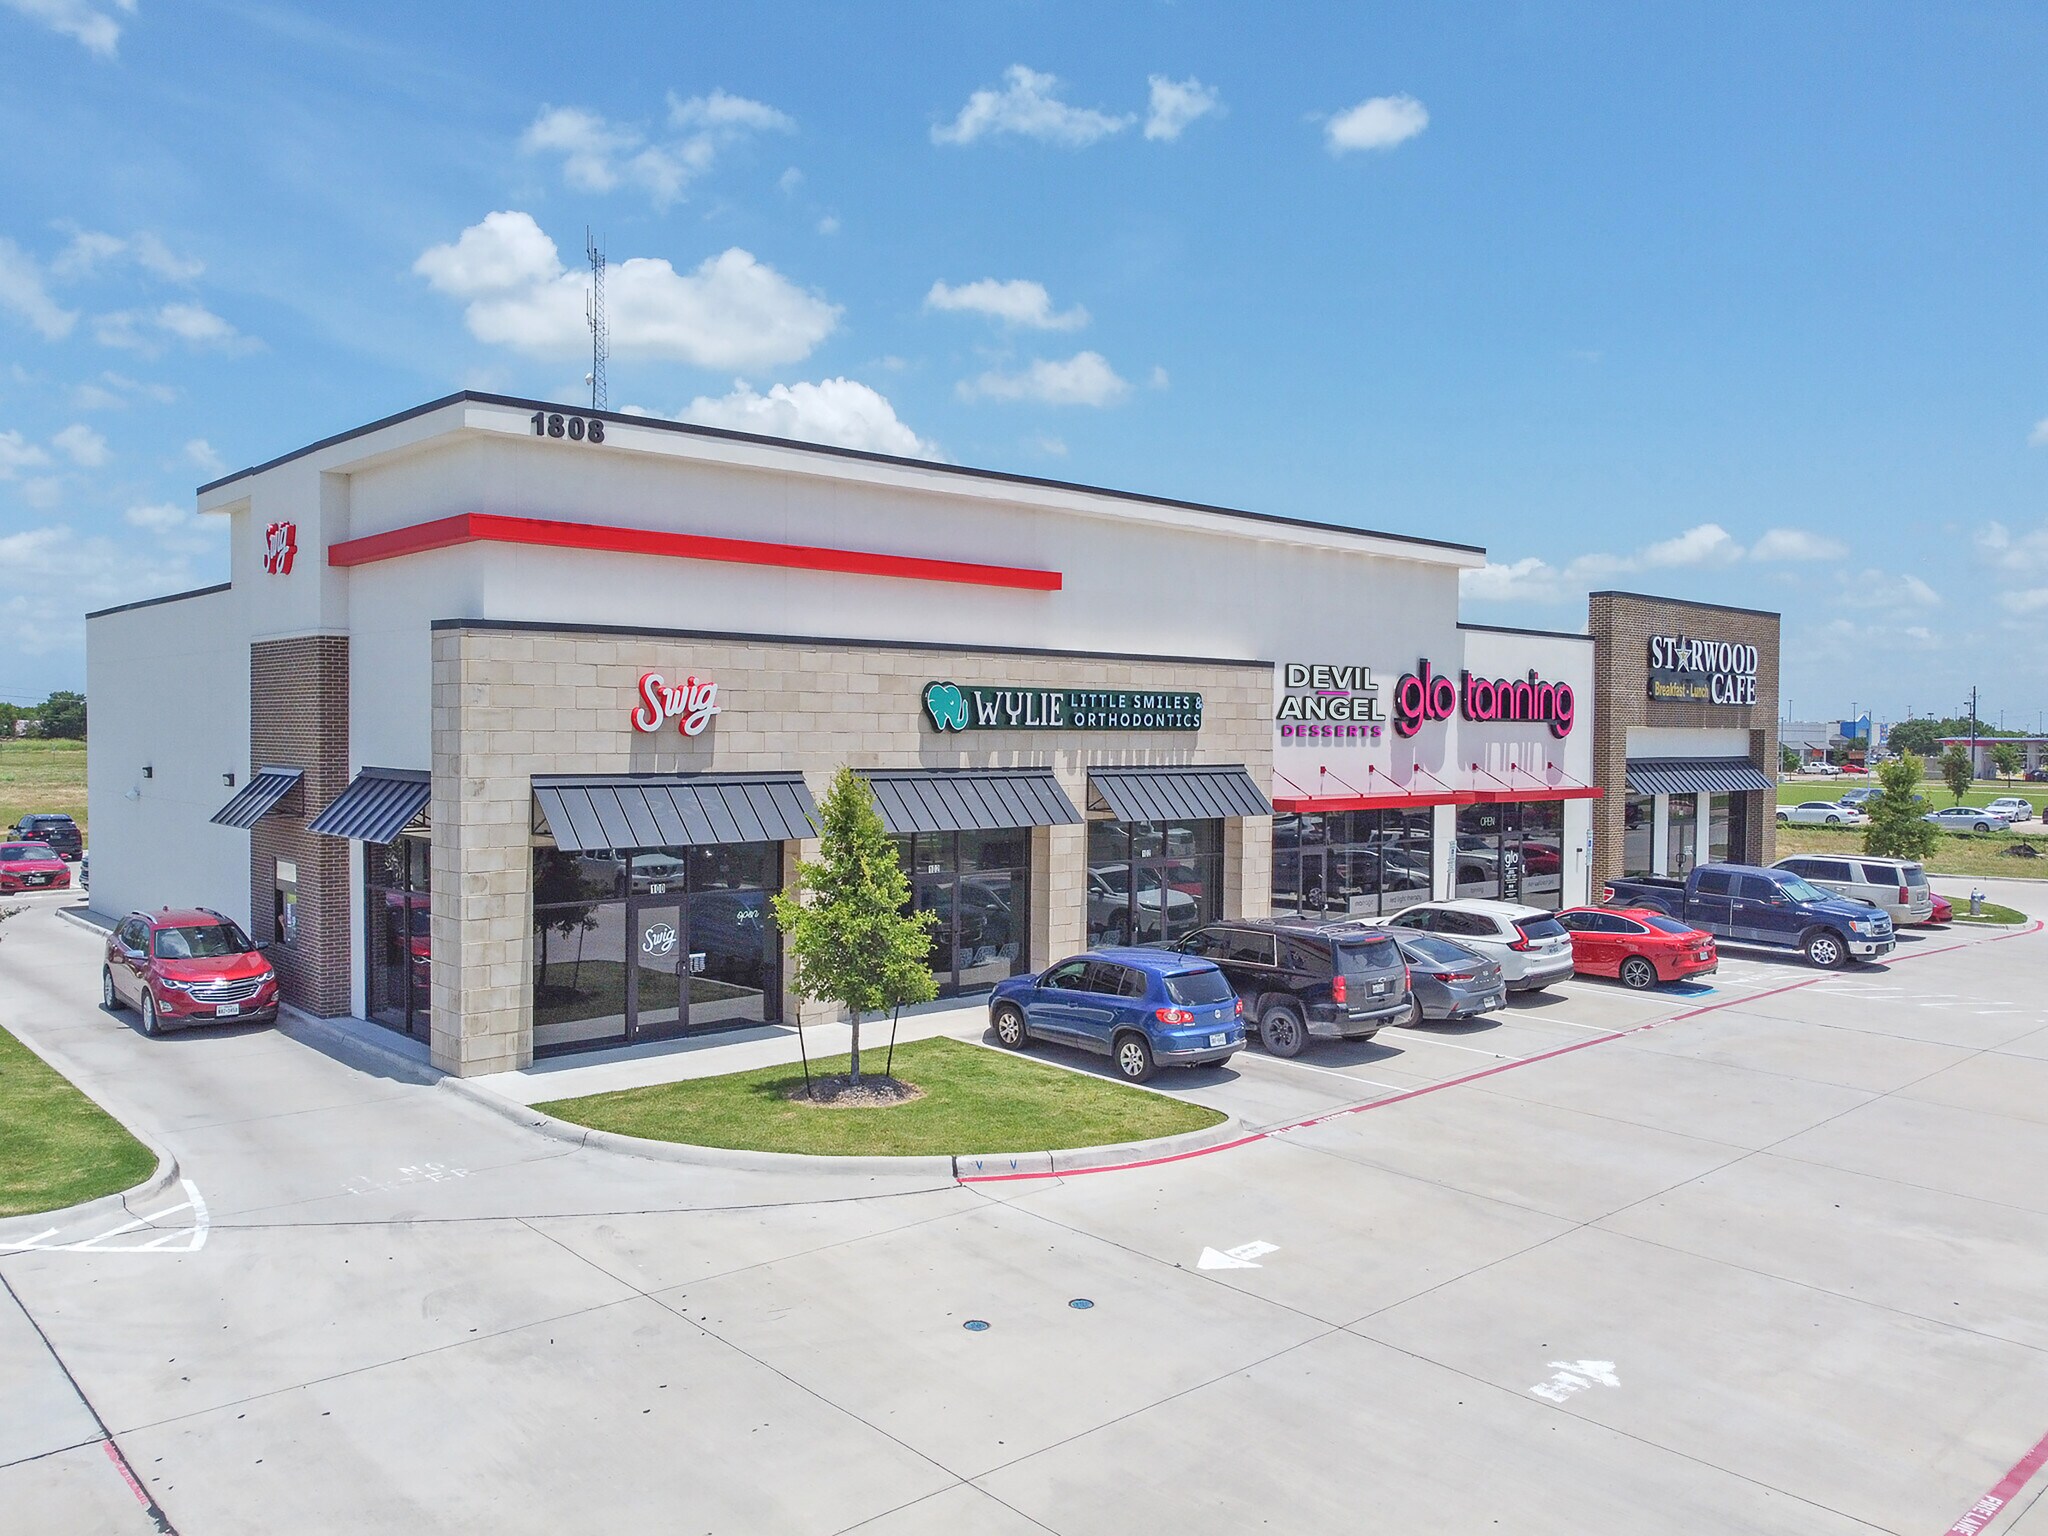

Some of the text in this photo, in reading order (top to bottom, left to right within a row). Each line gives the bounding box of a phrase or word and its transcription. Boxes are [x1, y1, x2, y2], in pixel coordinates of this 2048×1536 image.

[531, 411, 605, 444] 1808
[263, 521, 298, 575] Swig
[1286, 663, 1379, 691] DEVIL
[1654, 681, 1709, 698] Breakfast Lunch
[1711, 673, 1757, 705] CAFE
[631, 672, 721, 737] Swig
[973, 690, 1064, 727] WYLIE
[1070, 693, 1204, 711] LITTLE SMILES &
[1277, 696, 1386, 722] ANGEL
[1395, 658, 1575, 739] glo tanning
[1074, 712, 1200, 728] ORTHODONTICS
[1282, 724, 1383, 738] DESSERTS
[1480, 815, 1496, 827] OPEN
[1504, 850, 1519, 868] glo
[650, 884, 666, 894] 100
[737, 909, 760, 923] open
[642, 928, 676, 952] Swig
[1951, 1494, 2004, 1536] FIRE LANE
